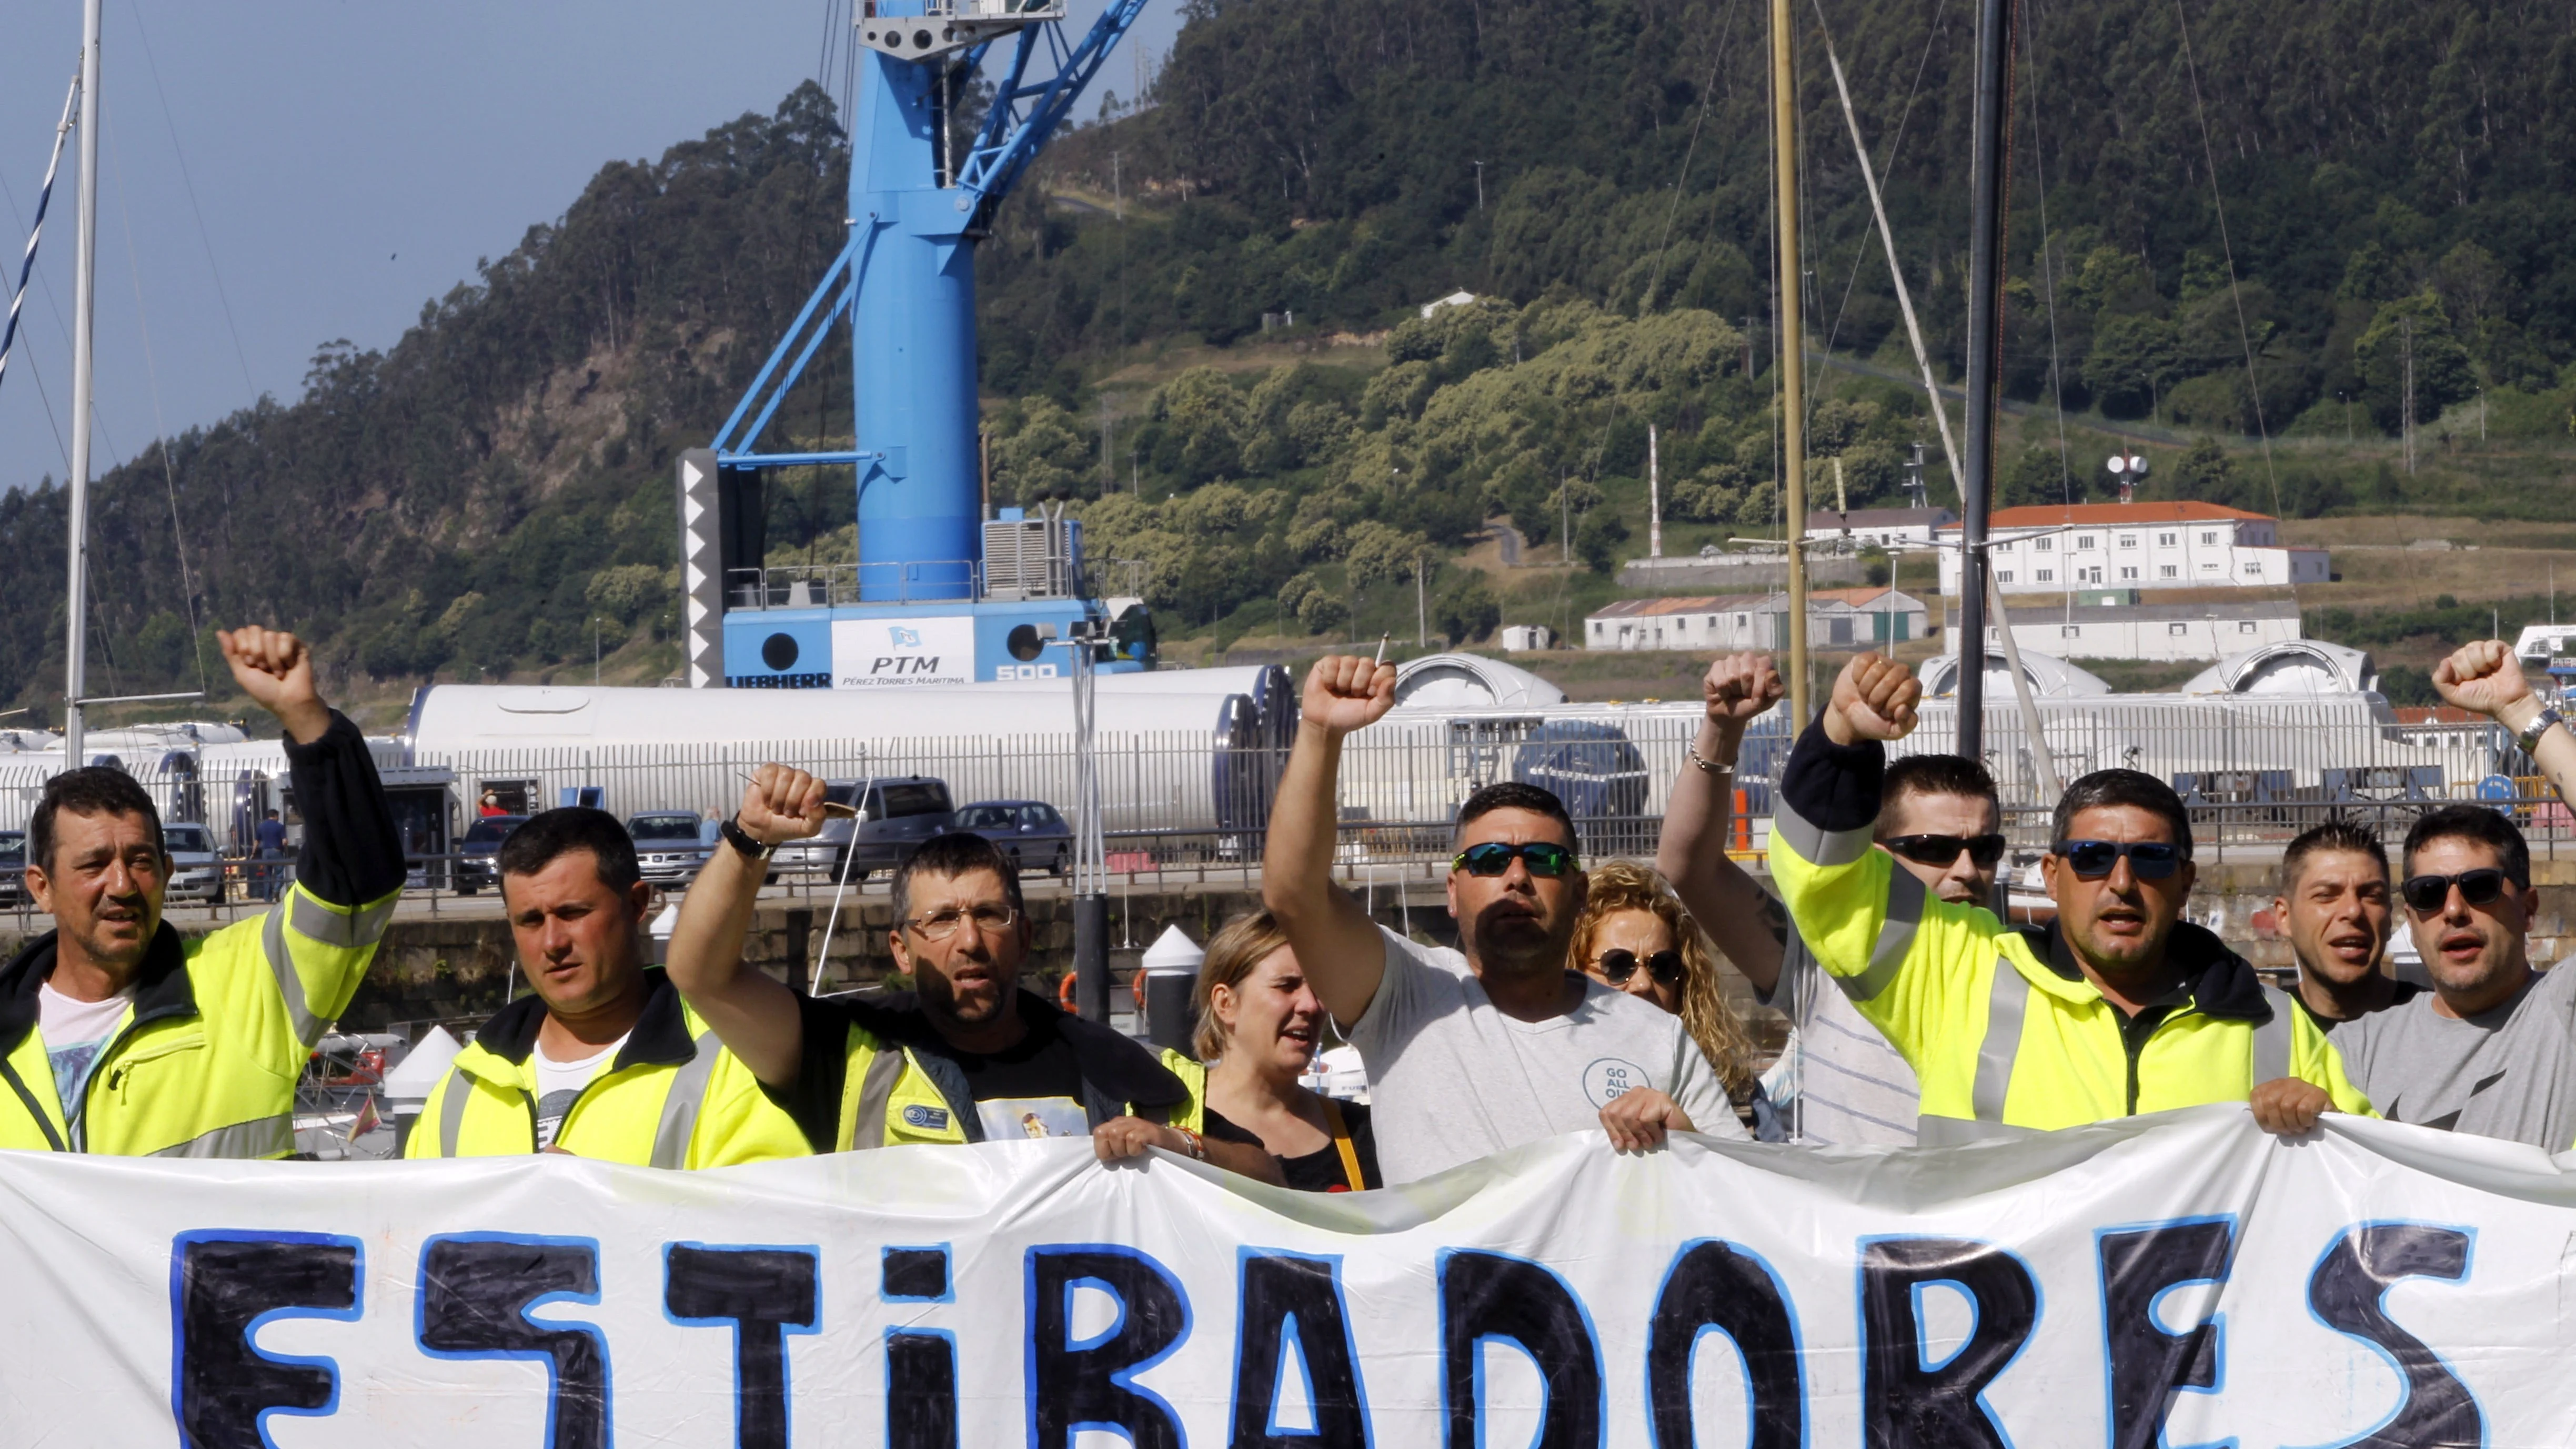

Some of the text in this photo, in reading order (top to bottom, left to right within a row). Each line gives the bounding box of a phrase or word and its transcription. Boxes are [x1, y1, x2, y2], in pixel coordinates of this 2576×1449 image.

[870, 656, 940, 674] PTM
[997, 663, 1057, 680] 500
[726, 673, 832, 689] LIEBHERR
[1606, 1068, 1627, 1078] GO
[1607, 1079, 1630, 1089] ALL
